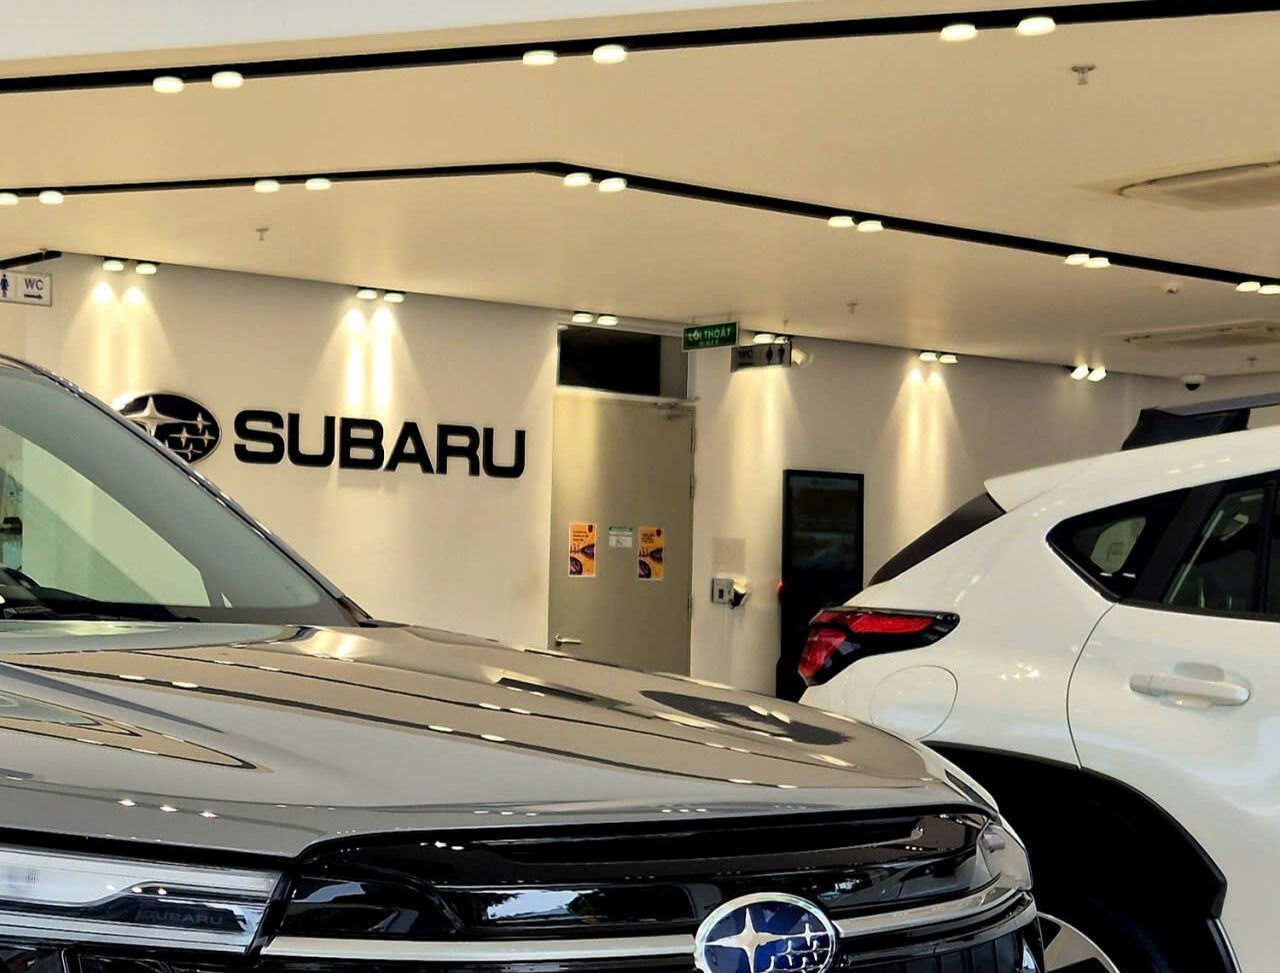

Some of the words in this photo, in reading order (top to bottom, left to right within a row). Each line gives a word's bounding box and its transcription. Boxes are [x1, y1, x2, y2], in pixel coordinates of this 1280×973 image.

[24, 278, 44, 291] WC
[737, 349, 753, 360] WC
[233, 409, 526, 478] SUBARU
[139, 908, 223, 925] SUBARU
